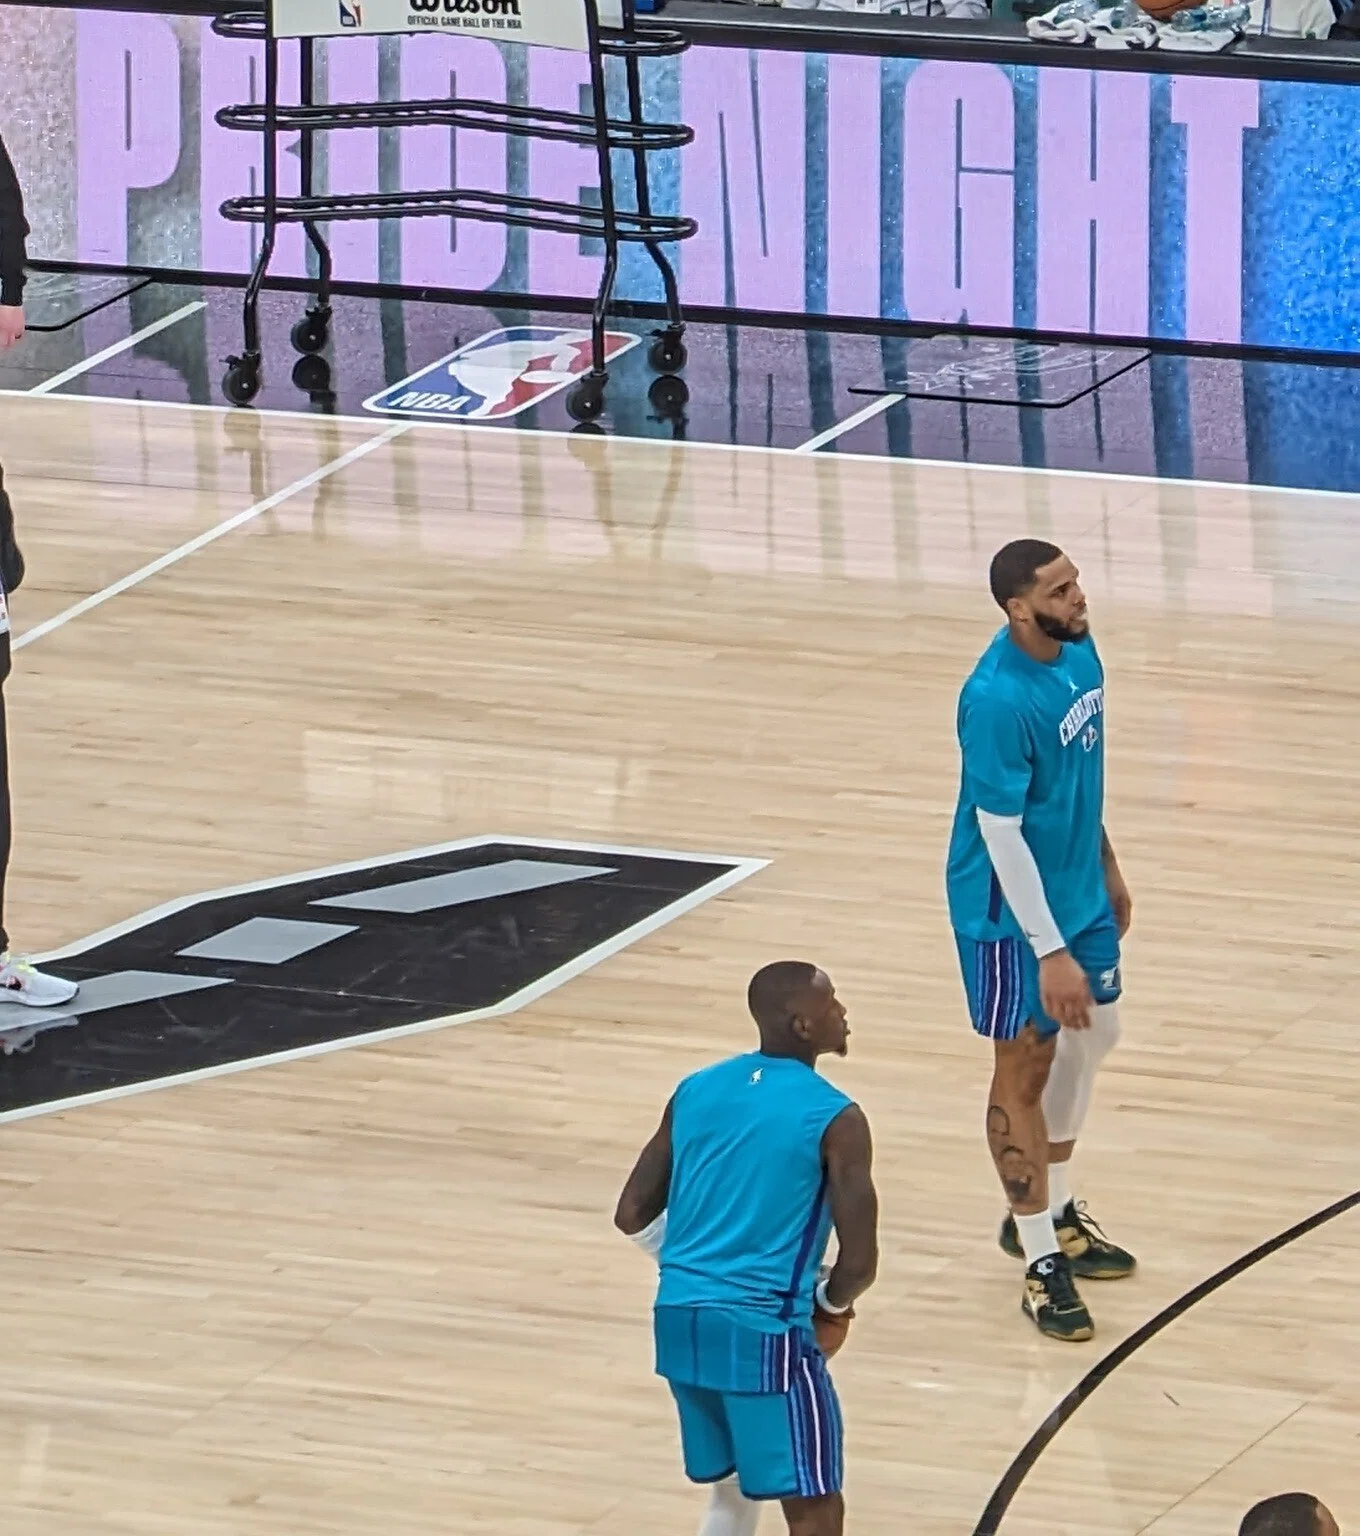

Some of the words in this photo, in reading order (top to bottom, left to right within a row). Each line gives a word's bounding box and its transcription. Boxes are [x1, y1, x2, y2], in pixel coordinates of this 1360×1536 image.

[407, 15, 439, 26] OFFICIAL
[441, 16, 461, 27] GAME
[462, 17, 480, 28] BALL
[481, 18, 492, 29] OF
[492, 18, 505, 29] THE
[76, 7, 607, 306] PRIDE
[680, 45, 1261, 345] NIGHT
[388, 391, 472, 411] NBA
